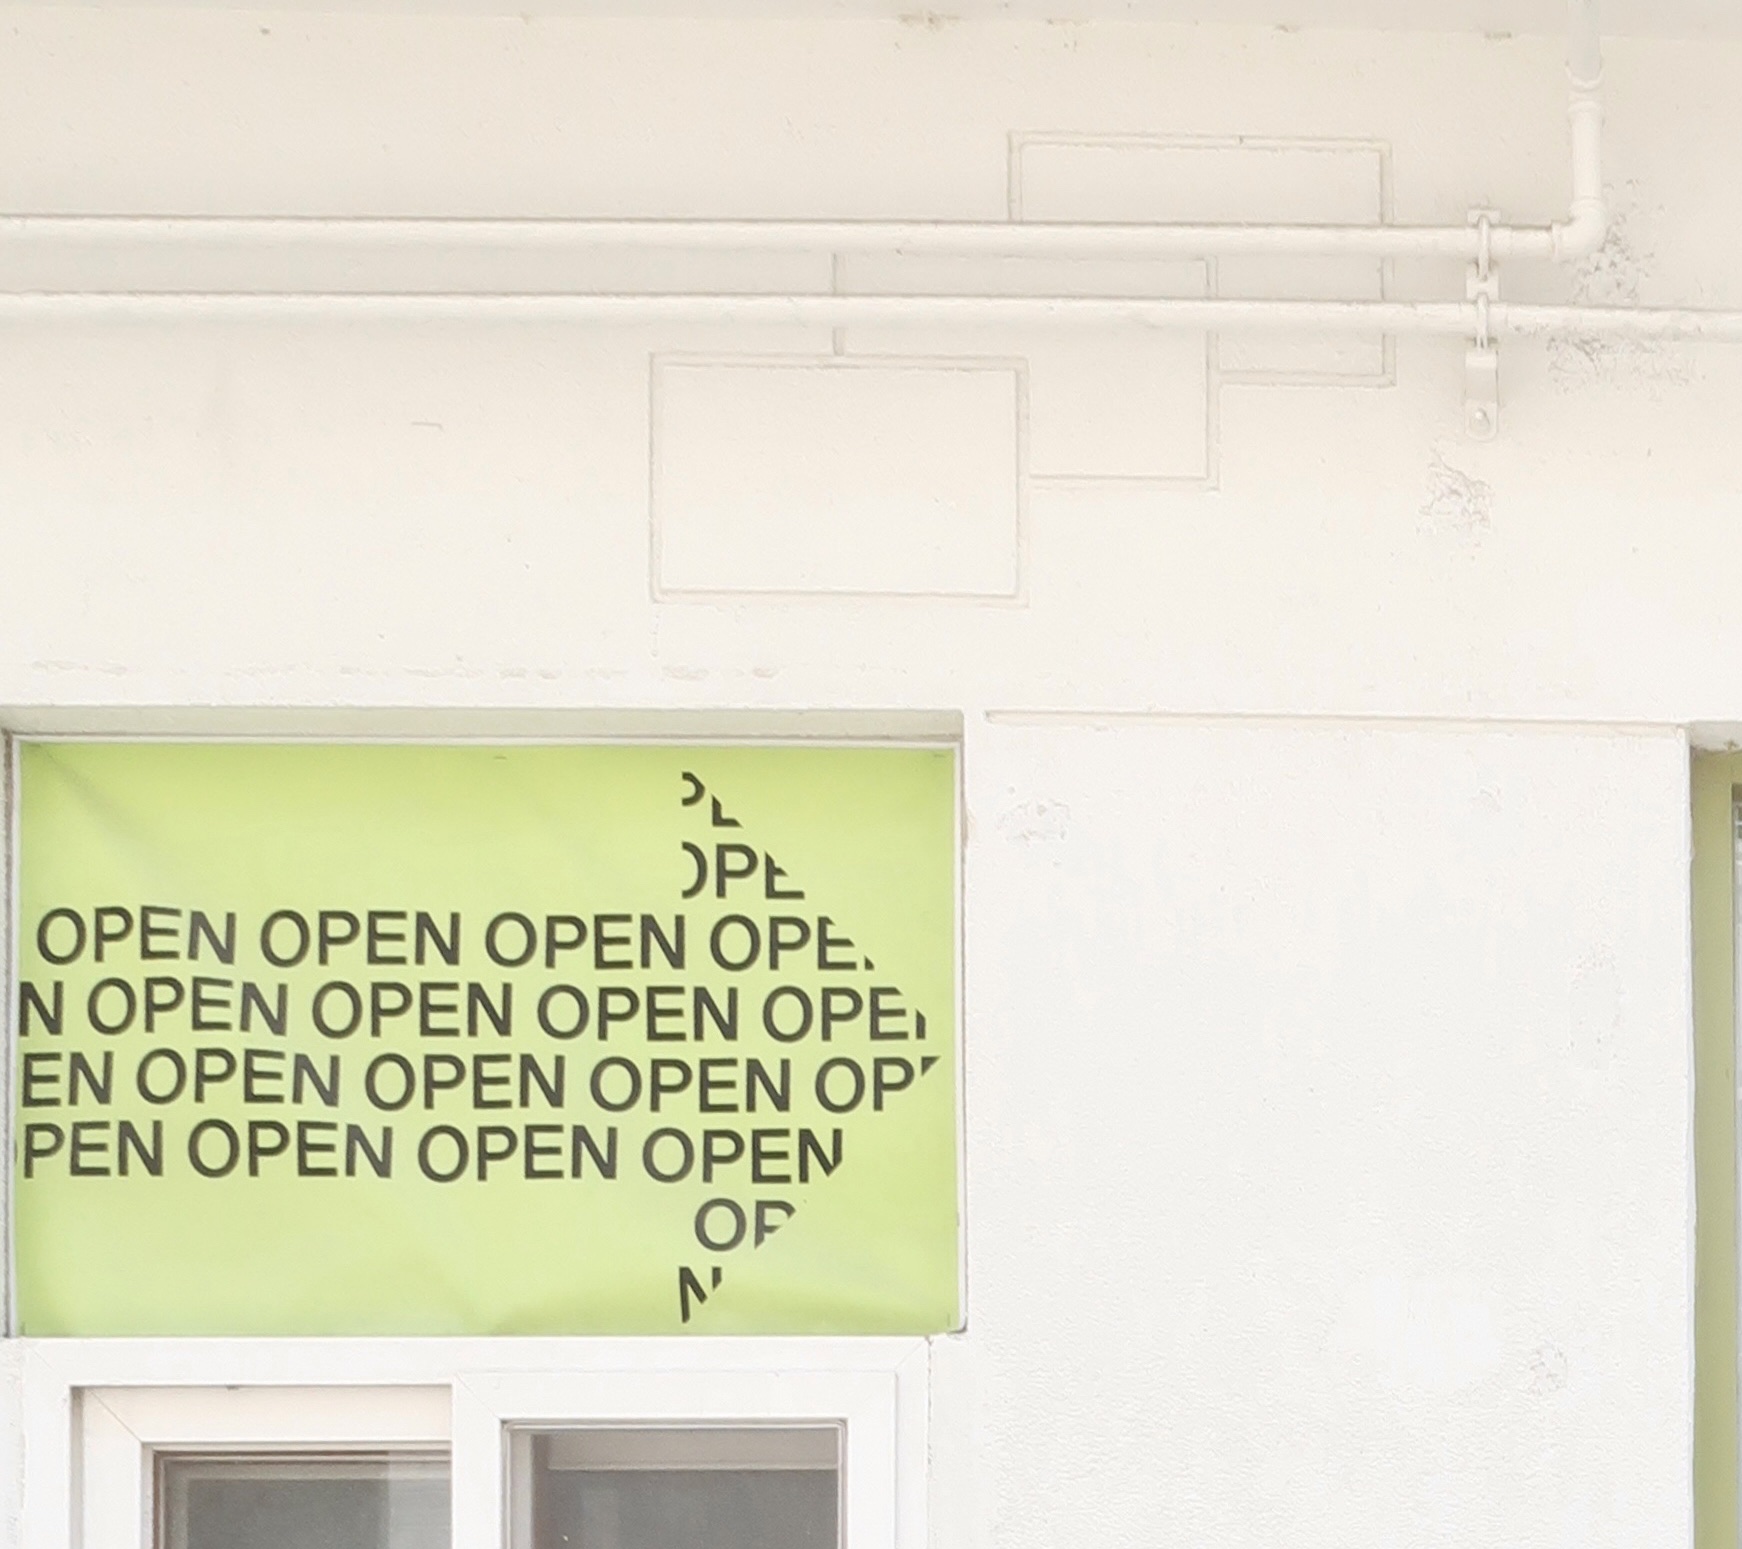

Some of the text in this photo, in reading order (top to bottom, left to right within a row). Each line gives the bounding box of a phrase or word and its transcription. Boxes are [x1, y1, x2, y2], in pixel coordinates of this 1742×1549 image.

[37, 905, 875, 971] OPEN OPEN OPEN OPE
[87, 976, 288, 1036] OPEN
[312, 981, 512, 1038] OPEN
[538, 985, 738, 1042] OPEN
[763, 986, 926, 1042] OPE
[22, 1048, 940, 1113] EN OPEN OPEN OPEN OP
[188, 1119, 393, 1178] OPEN
[418, 1124, 618, 1182] OPEN
[643, 1128, 843, 1183] OPEN
